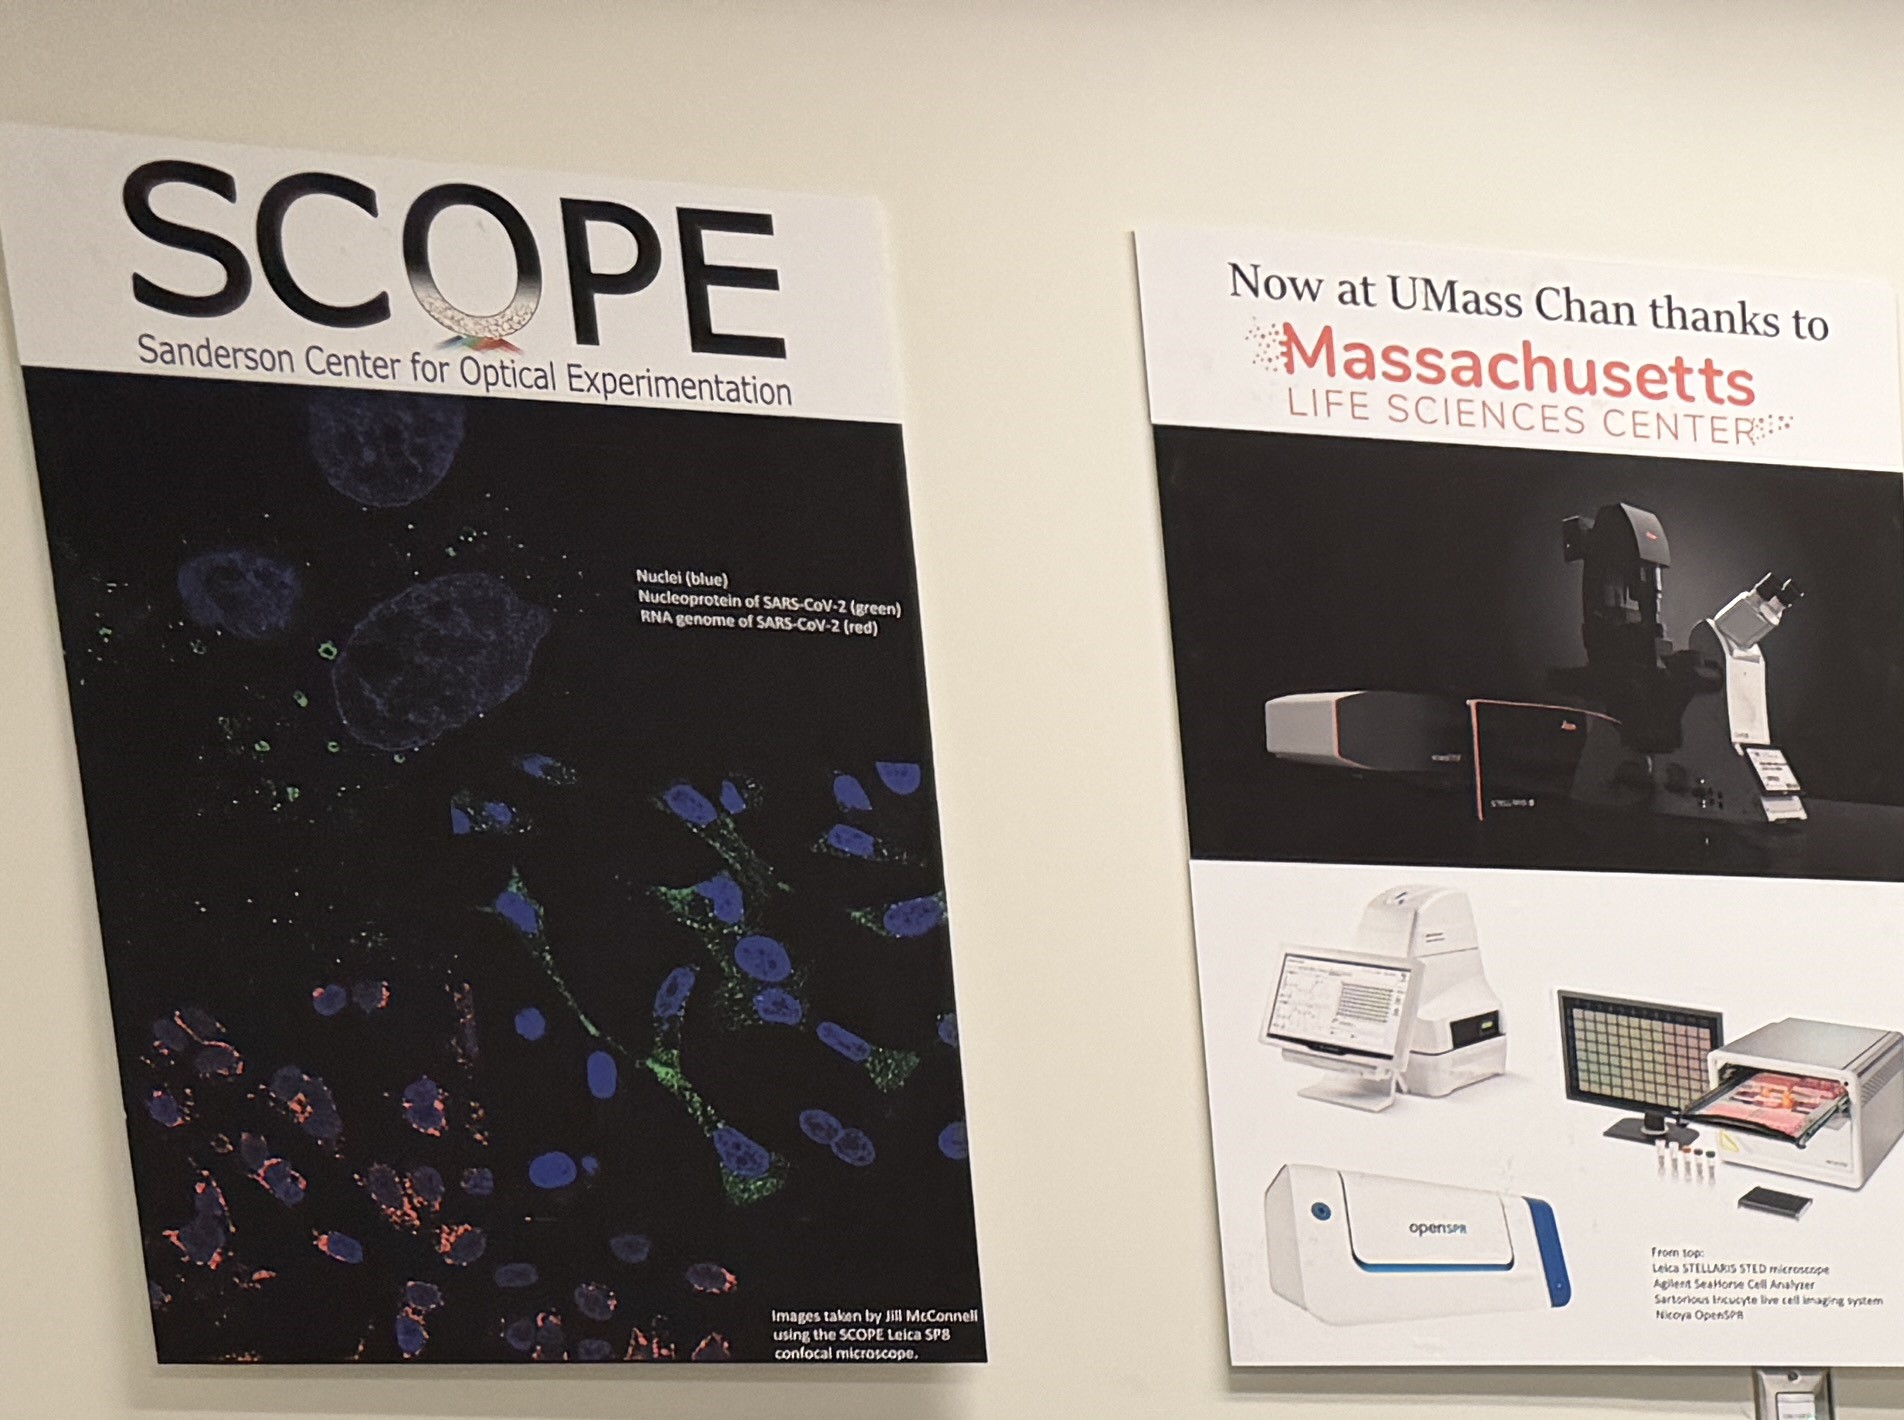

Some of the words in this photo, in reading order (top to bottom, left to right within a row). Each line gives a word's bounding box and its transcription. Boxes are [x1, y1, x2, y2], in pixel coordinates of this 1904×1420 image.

[121, 158, 787, 360] SCOPE
[1228, 262, 1325, 303] Now
[1337, 275, 1376, 309] at
[1388, 275, 1524, 319] UMass
[1535, 286, 1637, 328] Chan
[1649, 295, 1781, 338] thanks
[1791, 310, 1830, 343] to
[137, 334, 295, 375] Sanderson
[304, 345, 401, 382] Center
[410, 351, 448, 384] for
[459, 355, 558, 396] Optical
[567, 363, 794, 407] Experimentation
[1281, 321, 1757, 407] Massachusetts
[1287, 386, 1370, 422] LIFE
[1387, 393, 1586, 437] SCIENCES
[1602, 409, 1757, 447] CENTER
[636, 568, 682, 584] Nuclei
[686, 570, 728, 589] (blue)
[638, 589, 742, 608] Nucleoprotein
[745, 594, 761, 609] of
[763, 595, 847, 614] SARS-CoV-2
[850, 599, 901, 619] (green)
[641, 609, 673, 624] RNA
[676, 613, 735, 628] genome
[738, 614, 754, 628] of
[756, 615, 840, 633] SARS-CoV-2
[844, 619, 878, 637] (red)
[1651, 1246, 1679, 1258] From
[1682, 1248, 1705, 1260] top:
[1652, 1263, 1680, 1274] Leica
[1682, 1263, 1737, 1274] STELLARIS
[1739, 1263, 1767, 1274] STED
[1769, 1264, 1830, 1276] microscope
[1653, 1279, 1691, 1291] Agilent
[1747, 1279, 1767, 1290] Cell
[1770, 1279, 1815, 1291] Analyzer
[1761, 1294, 1779, 1305] live
[1782, 1295, 1800, 1305] cell
[1802, 1295, 1845, 1308] imaging
[1847, 1297, 1884, 1308] system
[772, 1309, 821, 1325] Images
[824, 1309, 862, 1323] taken
[866, 1309, 882, 1325] by
[885, 1309, 902, 1323] Jill
[906, 1309, 978, 1323] McConnell
[1656, 1309, 1692, 1322] Nicoya
[1694, 1310, 1744, 1322] OpenSPR
[773, 1328, 811, 1344] using
[813, 1328, 836, 1341] the
[839, 1328, 884, 1341] SCOPE
[887, 1328, 922, 1341] Leica
[924, 1328, 951, 1341] SP8
[774, 1346, 832, 1360] confocal
[836, 1347, 919, 1362] microscope.
